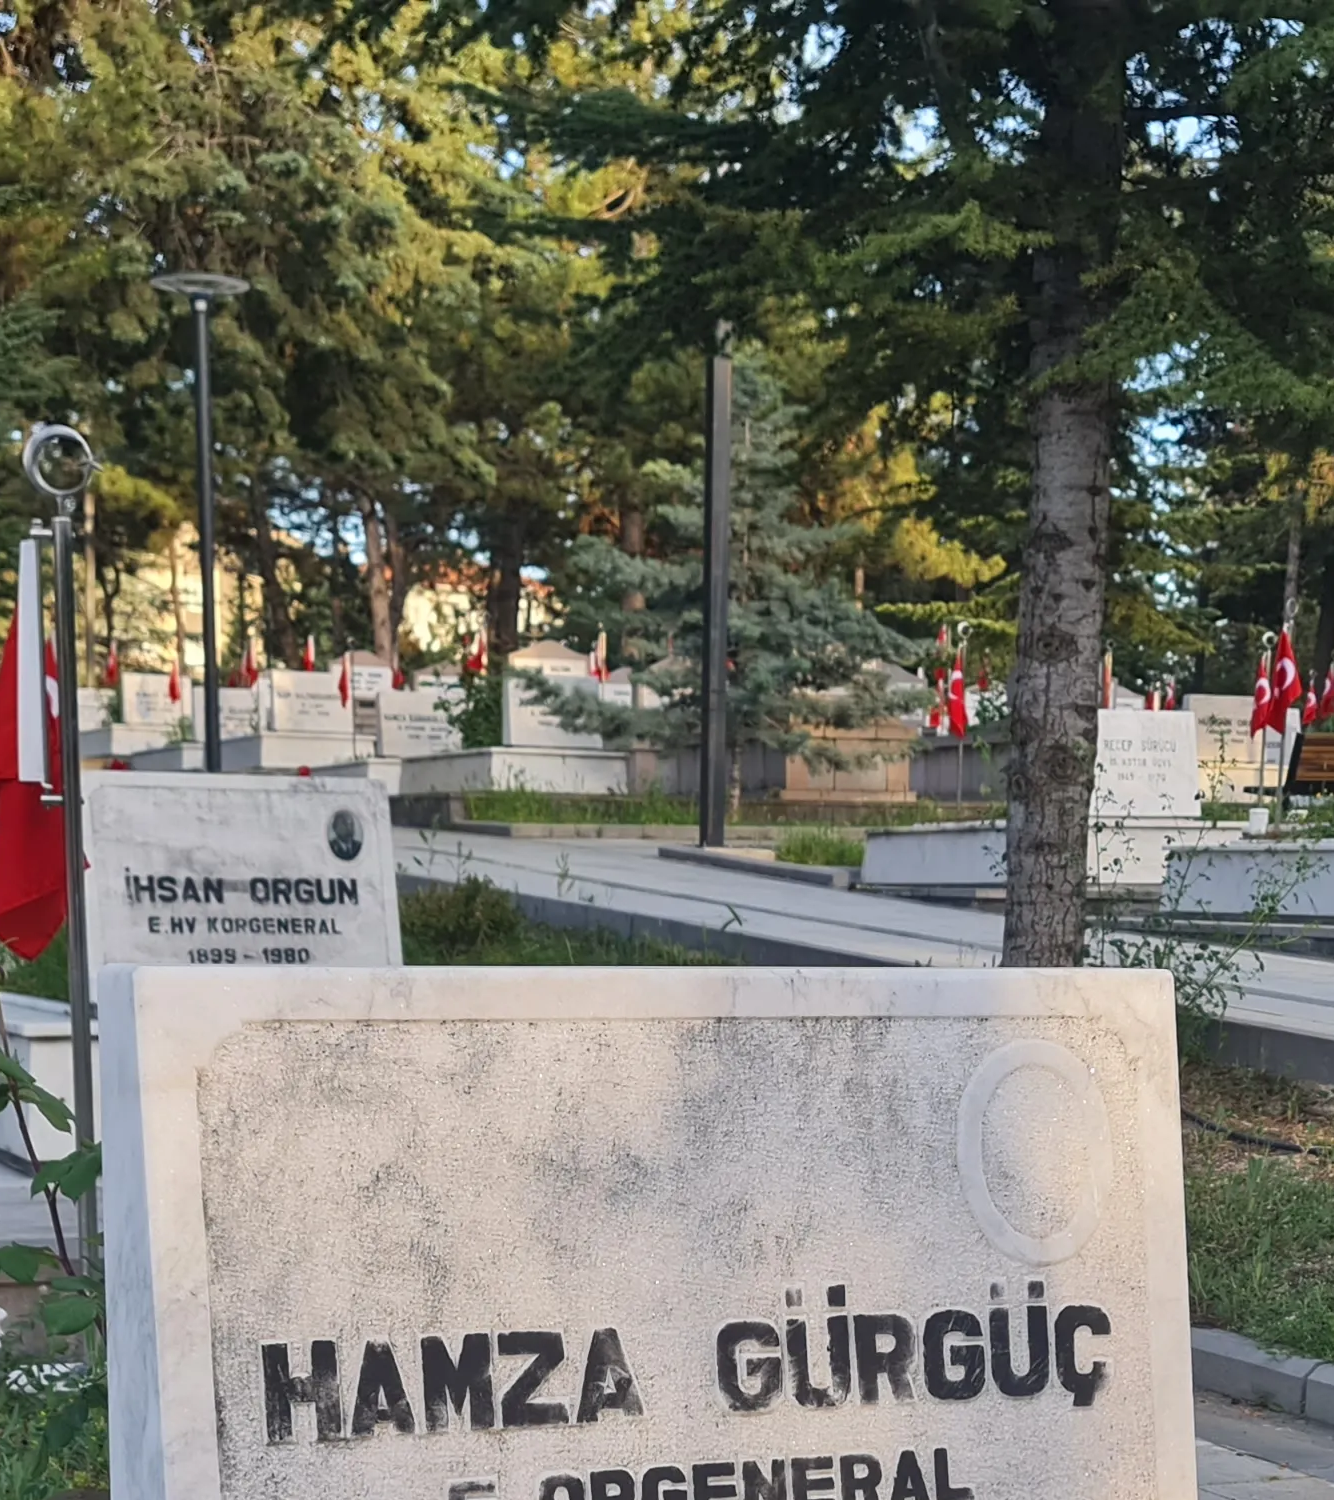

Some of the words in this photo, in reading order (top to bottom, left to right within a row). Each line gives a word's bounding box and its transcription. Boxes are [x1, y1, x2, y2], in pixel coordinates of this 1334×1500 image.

[124, 866, 225, 905] İHSAN
[249, 877, 359, 905] ORGUN
[207, 916, 343, 936] KORGENERAL
[261, 947, 311, 964] 1980
[259, 1326, 647, 1445] HAMZA
[715, 1280, 1114, 1413] GÜRGÜÇ
